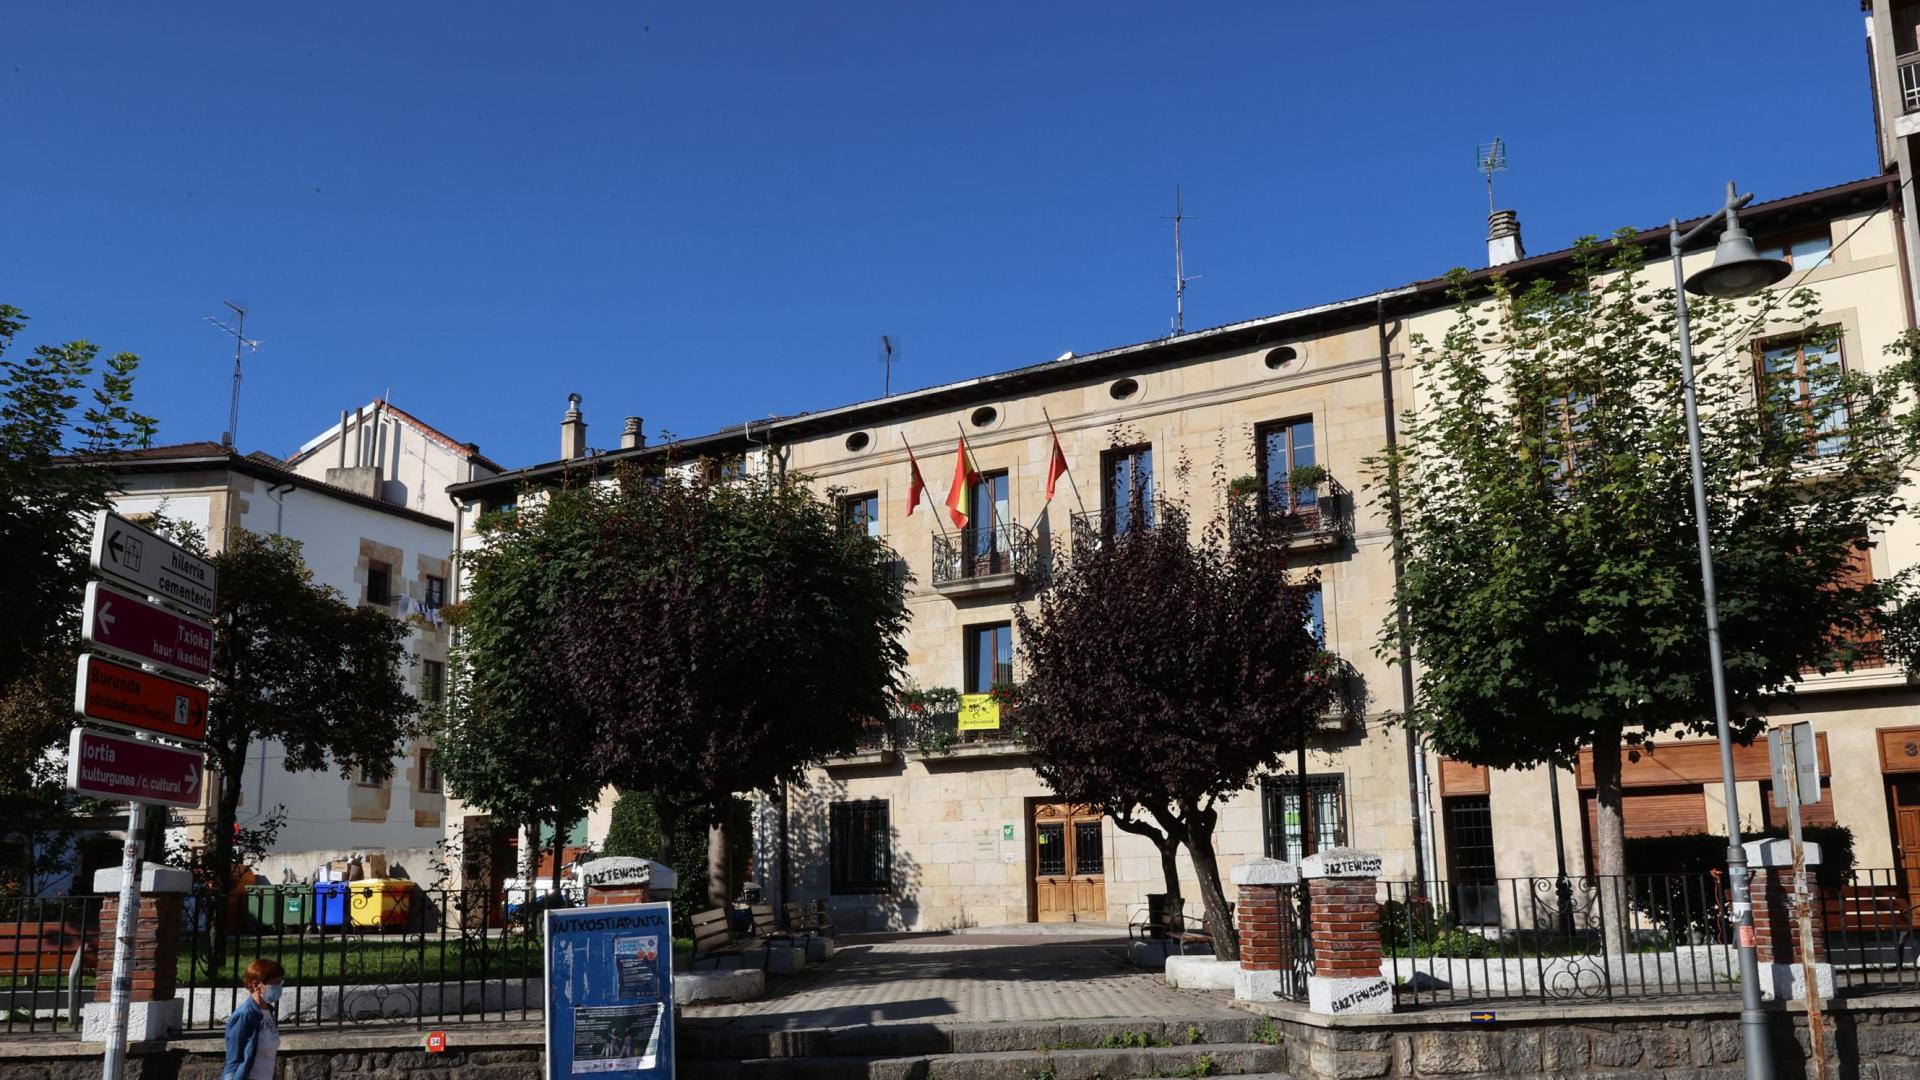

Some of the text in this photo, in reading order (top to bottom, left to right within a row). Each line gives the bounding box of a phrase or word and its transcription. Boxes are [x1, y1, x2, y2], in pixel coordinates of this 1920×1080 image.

[172, 551, 205, 580] hilerria
[159, 577, 212, 609] cementerio
[178, 624, 209, 650] Txioka
[91, 667, 141, 695] Burunda
[1905, 741, 1918, 757] 3
[81, 765, 135, 787] kulturgunea
[151, 777, 181, 793] cultural
